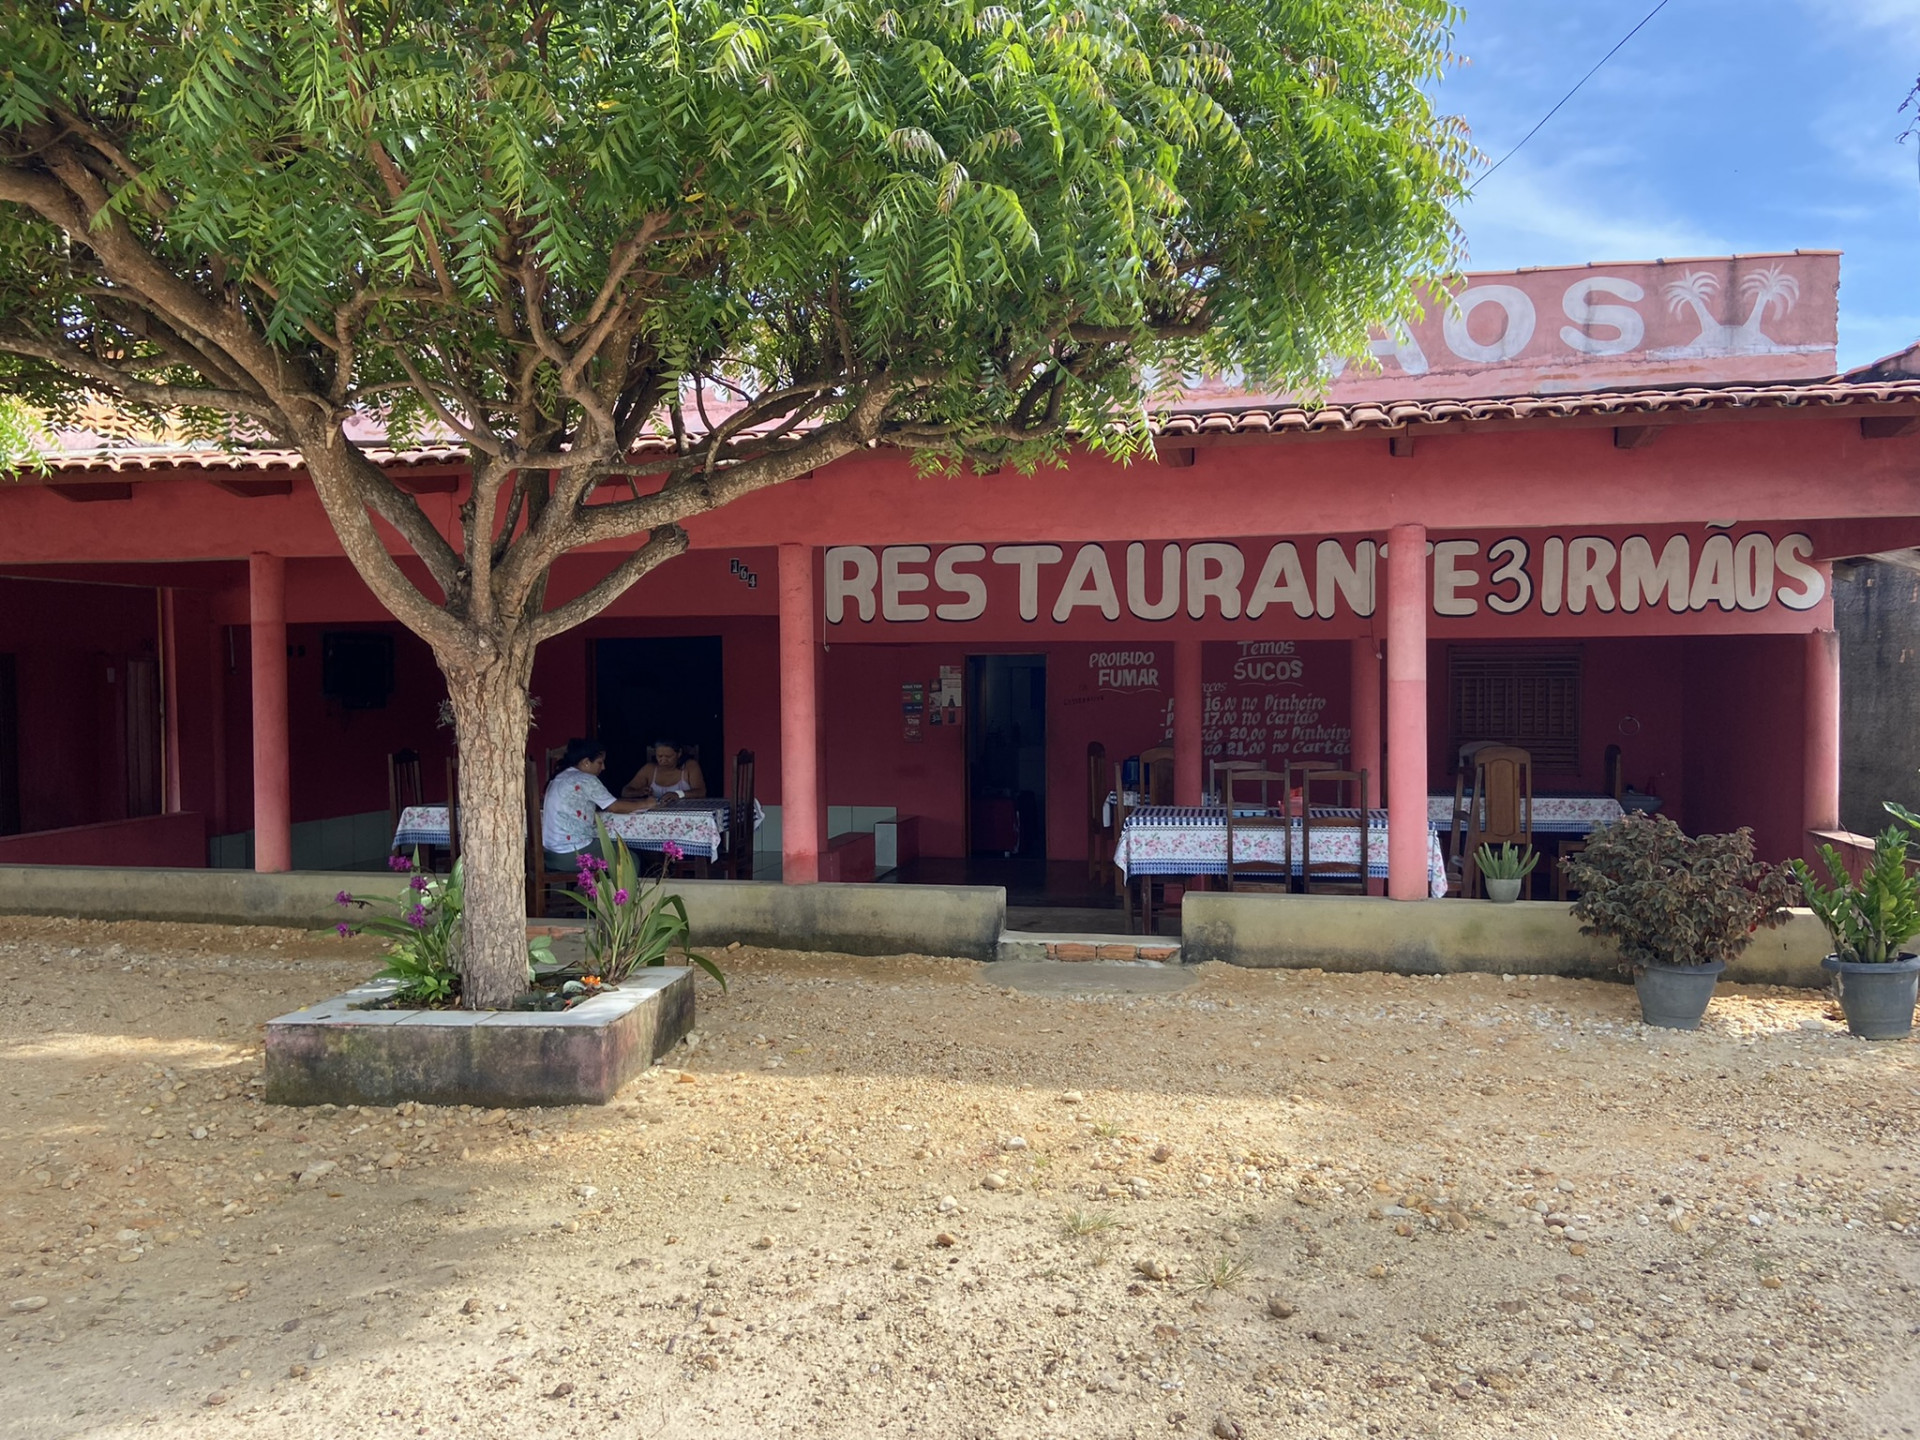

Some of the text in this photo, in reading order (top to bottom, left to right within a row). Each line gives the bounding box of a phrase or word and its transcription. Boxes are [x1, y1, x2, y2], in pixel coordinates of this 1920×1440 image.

[731, 559, 757, 588] 164
[1486, 536, 1534, 615] 3
[1541, 519, 1827, 615] IRMÃOS
[1237, 640, 1296, 657] Temos
[1089, 652, 1155, 668] PROIBIDO
[1098, 668, 1160, 687] FUMAR
[1233, 660, 1304, 681] SUCOS
[1241, 697, 1259, 711] no
[1264, 693, 1327, 711] Dinheiro
[1242, 711, 1261, 726] no
[1266, 710, 1320, 725] Cartão
[1273, 728, 1288, 740] no
[1272, 742, 1289, 754] no
